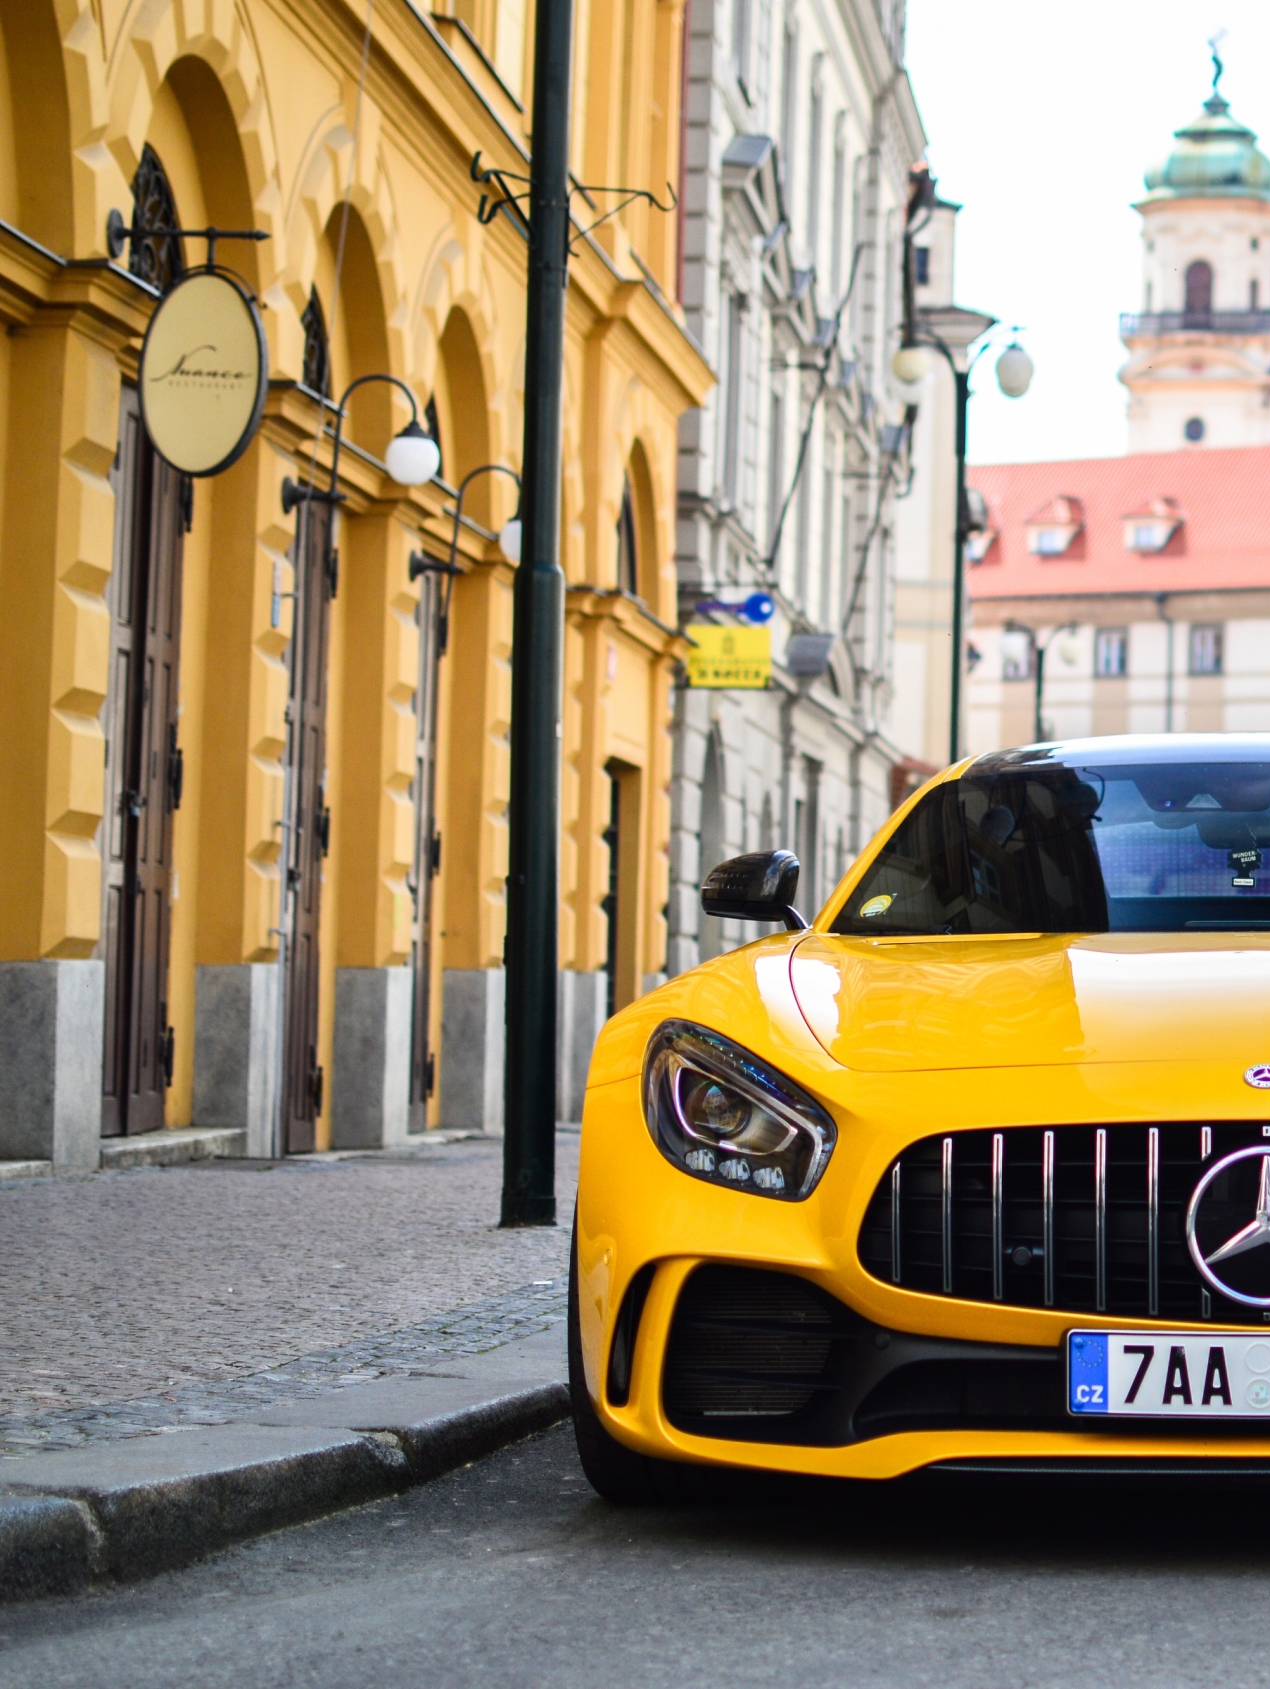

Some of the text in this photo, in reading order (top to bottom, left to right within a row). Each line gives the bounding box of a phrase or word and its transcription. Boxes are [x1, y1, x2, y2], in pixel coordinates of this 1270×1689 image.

[149, 344, 252, 382] Nuance
[1076, 1385, 1104, 1403] CZ
[1123, 1345, 1233, 1406] 7AA
